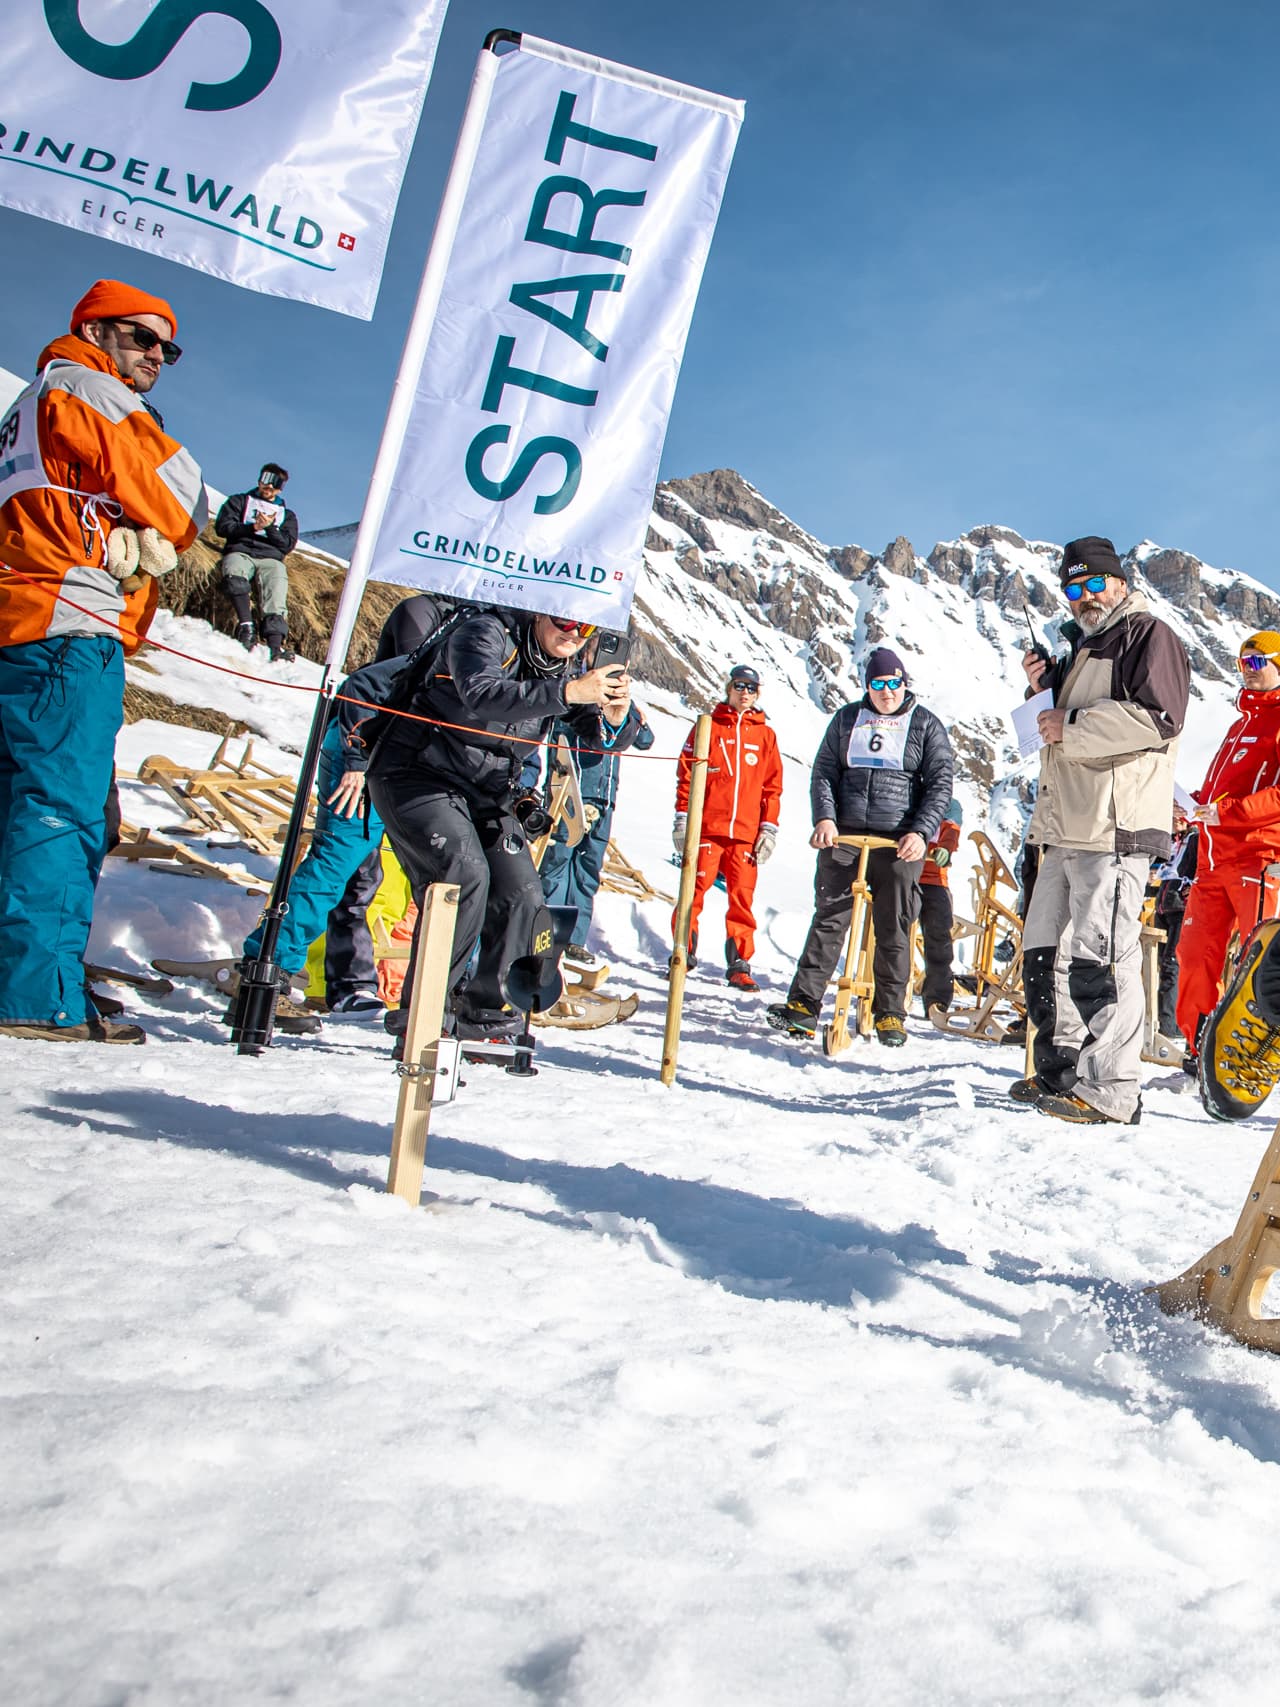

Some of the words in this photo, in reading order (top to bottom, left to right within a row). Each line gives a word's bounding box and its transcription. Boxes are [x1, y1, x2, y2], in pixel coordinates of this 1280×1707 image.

[0, 122, 324, 249] INDELWALD
[81, 199, 165, 239] EIGER
[465, 90, 658, 515] START
[413, 530, 607, 584] GRINDELWALD
[482, 578, 525, 592] EIGER
[869, 733, 885, 752] 6
